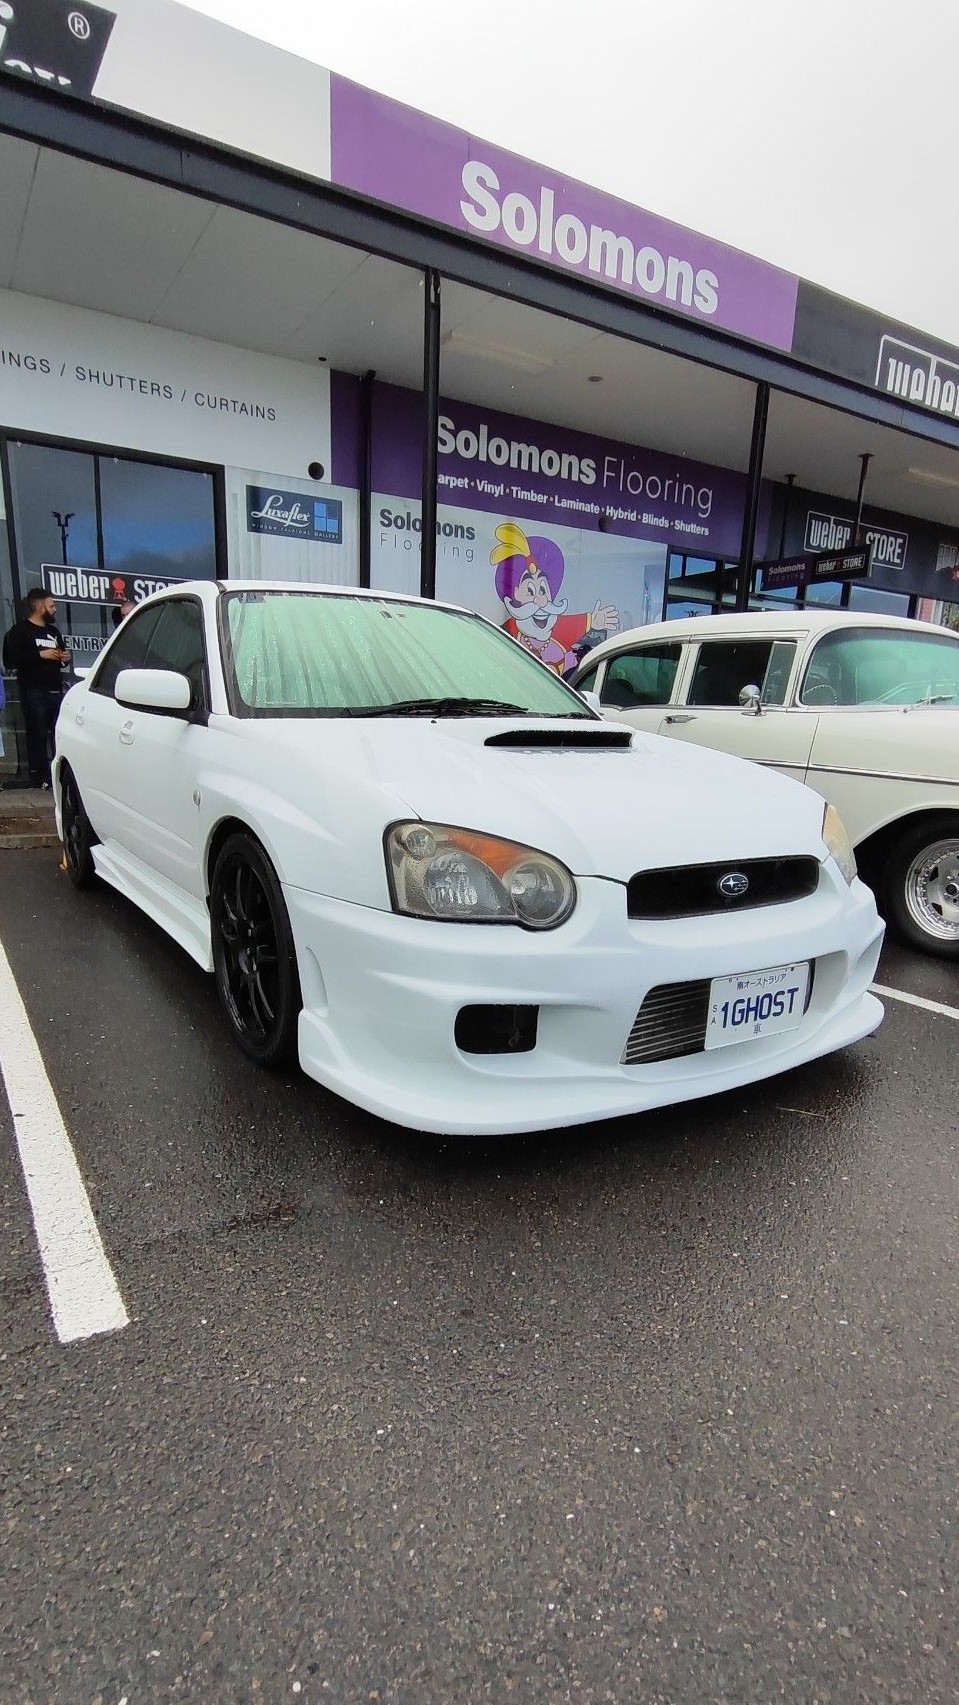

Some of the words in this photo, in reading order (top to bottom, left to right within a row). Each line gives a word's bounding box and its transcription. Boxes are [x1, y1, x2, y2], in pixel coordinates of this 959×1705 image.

[459, 160, 719, 314] Solomons
[1, 350, 51, 374] INGS
[75, 366, 173, 399] SHUTTERS
[194, 392, 276, 421] CURTAINS
[437, 415, 597, 485] Solomons
[603, 456, 713, 518] Flooring
[251, 494, 311, 528] Luxaflex
[437, 473, 470, 489] arpet
[475, 478, 505, 498] Vinyl
[511, 486, 549, 504] Timber
[554, 494, 601, 514] Laminate
[605, 505, 637, 521] Hybrid
[642, 512, 670, 528] Blinds
[674, 519, 710, 536] Shutters
[379, 508, 476, 541] Soloons
[809, 517, 851, 551] weber
[380, 532, 475, 563] Floing
[842, 556, 863, 569] STORE
[47, 568, 110, 600] weber
[768, 562, 806, 576] Solomons
[721, 986, 799, 1029] 1GHOST
